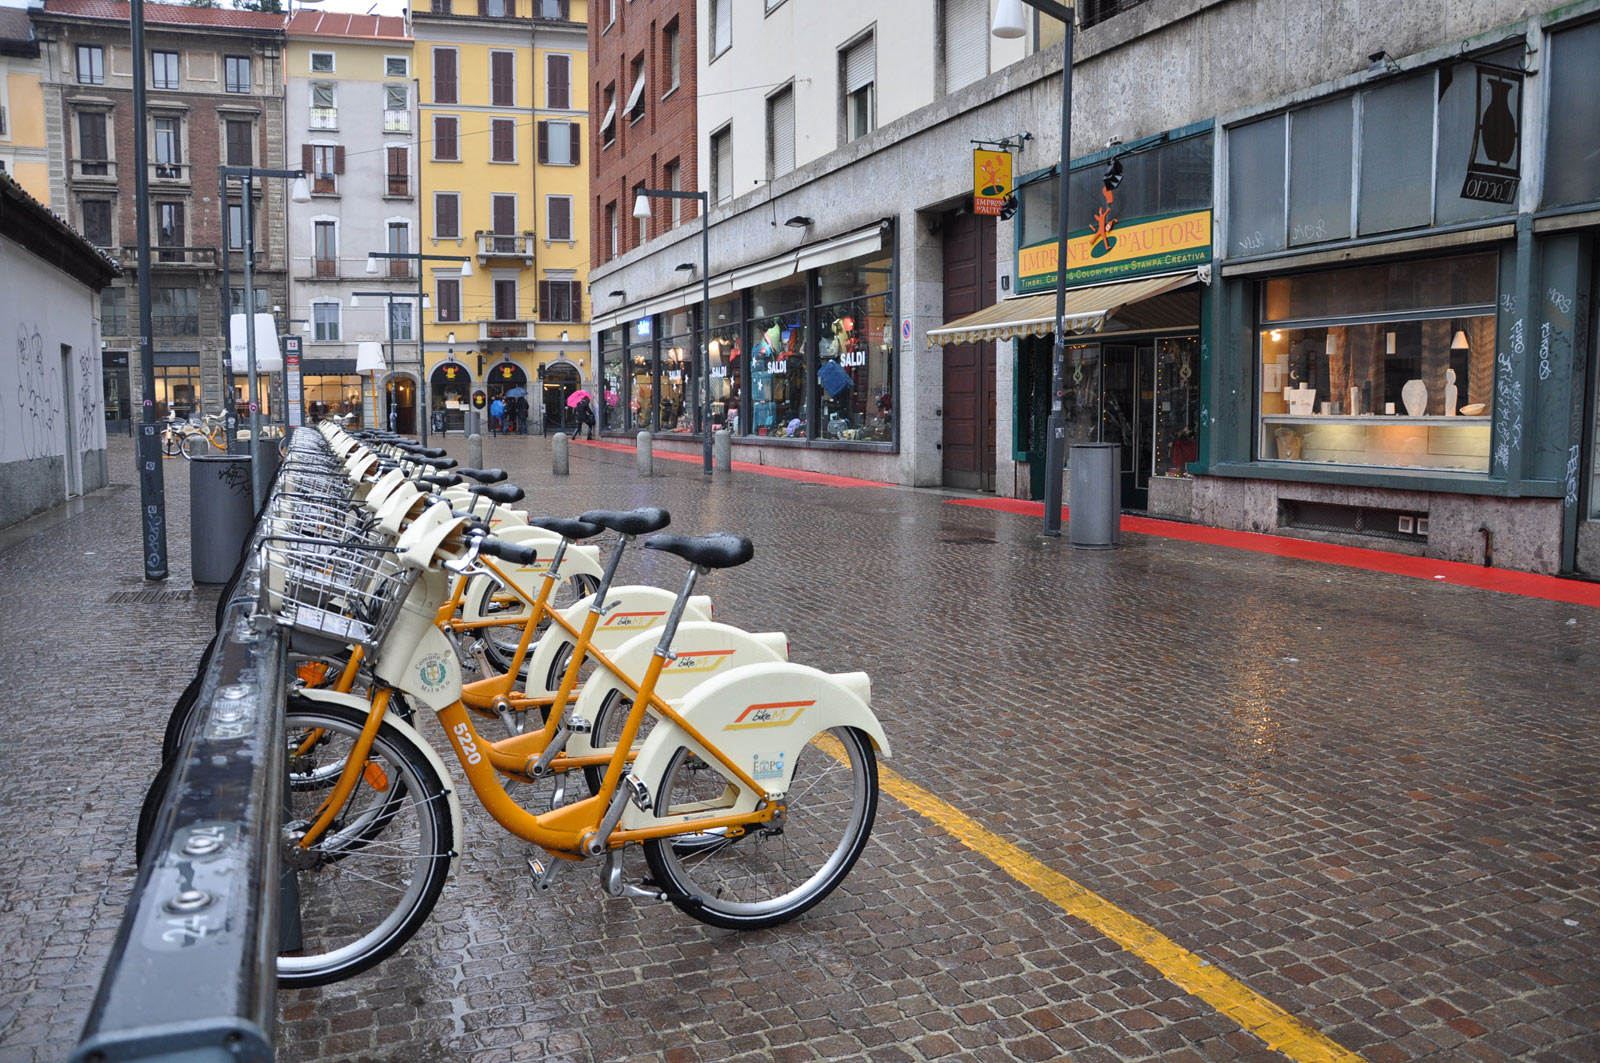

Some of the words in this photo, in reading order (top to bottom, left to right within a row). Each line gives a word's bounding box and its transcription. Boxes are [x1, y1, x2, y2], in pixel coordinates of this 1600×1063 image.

[976, 198, 1004, 206] IMPRON
[1022, 242, 1089, 271] IMPRNTE
[1119, 218, 1204, 252] D'AUTORE
[767, 360, 787, 374] SALDI
[840, 351, 866, 368] SALDI
[711, 365, 727, 378] SALDI
[415, 655, 441, 670] Comune
[420, 680, 450, 693] Milano
[453, 722, 482, 765] 5220
[162, 915, 208, 942] 24
